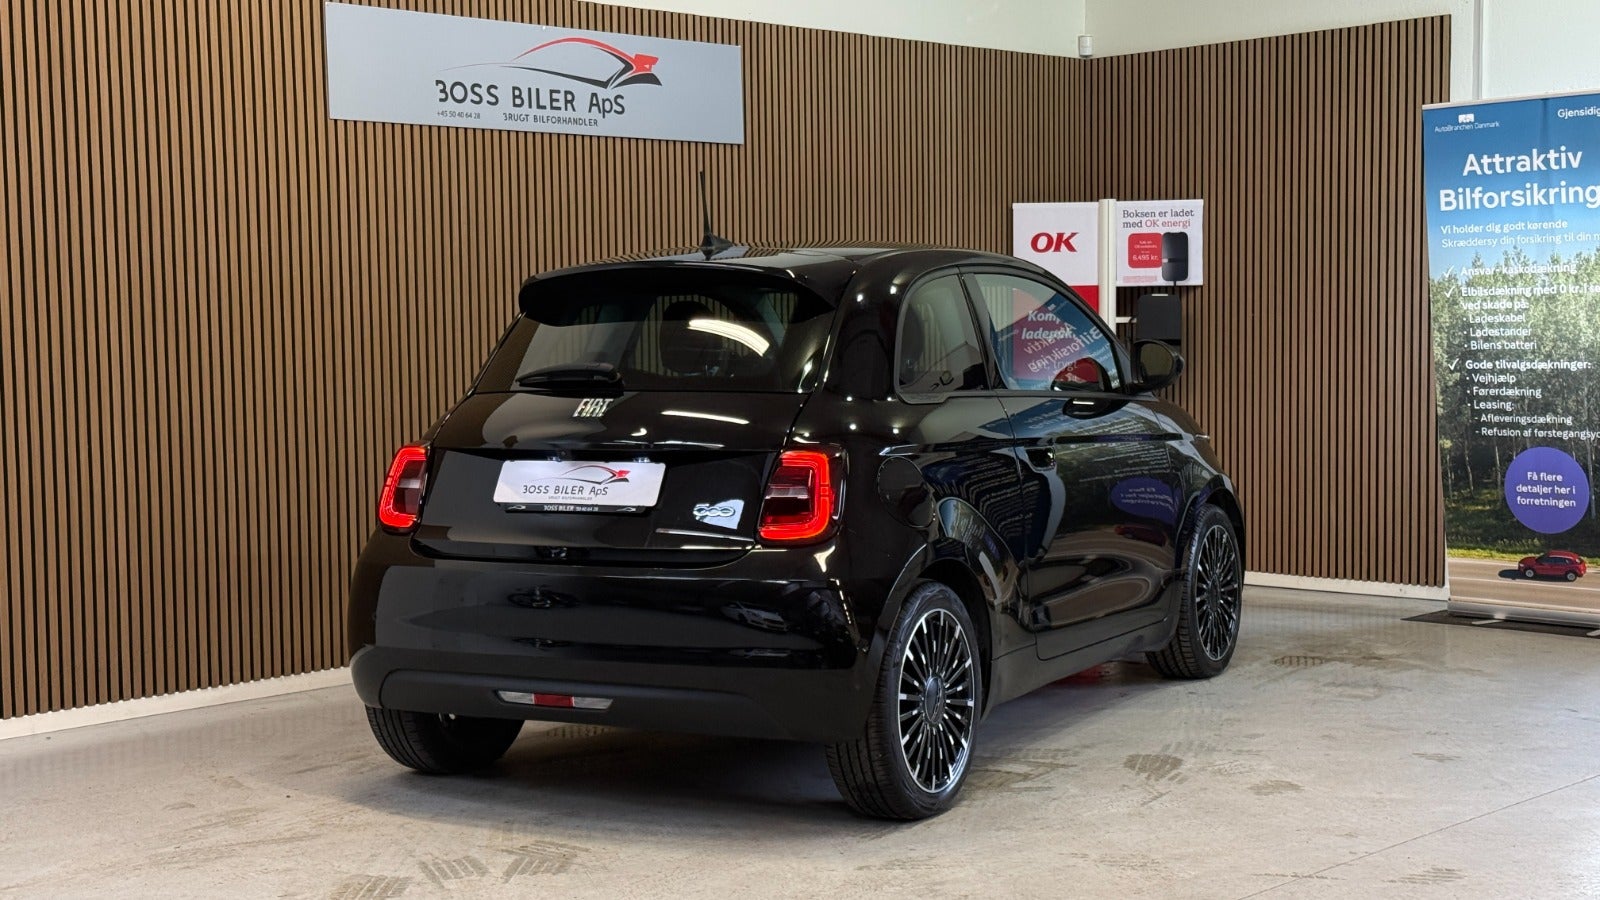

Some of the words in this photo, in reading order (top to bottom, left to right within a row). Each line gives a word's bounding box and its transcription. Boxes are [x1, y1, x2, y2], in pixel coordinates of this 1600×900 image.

[511, 86, 576, 112] BILER
[588, 92, 625, 119] ApS
[533, 115, 598, 127] BILFORHANDLER
[1474, 121, 1500, 129] Danmark
[1463, 145, 1583, 176] Attraktiv
[1439, 181, 1600, 211] Bilforsikring
[1122, 209, 1156, 218] Boksen
[1158, 210, 1168, 218] er
[1170, 208, 1195, 218] ladet
[1122, 220, 1143, 229] med
[1144, 219, 1160, 228] OK
[1161, 218, 1191, 229] energi
[1441, 224, 1452, 234] Vi
[1453, 223, 1483, 233] holder
[1486, 221, 1501, 233] dig
[1503, 220, 1526, 233] godt
[1527, 218, 1568, 230] kørende
[1030, 232, 1080, 253] OK
[1442, 235, 1498, 248] Skræddersy
[1500, 233, 1515, 244] din
[1517, 232, 1562, 246] forsikring
[1564, 231, 1575, 241] til
[1576, 231, 1591, 241] din
[1461, 285, 1532, 298] Elbilsdækning
[1533, 284, 1557, 296] med
[1559, 283, 1567, 294] 0
[1462, 299, 1481, 310] ved
[1482, 299, 1513, 310] skade
[1469, 313, 1527, 324] Ladeskabel
[1469, 327, 1532, 338] Ladestander
[1470, 341, 1502, 350] Bilens
[1503, 340, 1537, 350] batteri
[1465, 360, 1494, 370] Gode
[1472, 373, 1517, 385] Vejhjælp
[1473, 386, 1542, 398] Førerdækning
[572, 398, 614, 418] FIAT
[1480, 413, 1573, 426] Afleveringsdækning
[1481, 427, 1521, 437] Refusion
[1522, 428, 1532, 438] af
[1527, 471, 1538, 481] Få
[1540, 471, 1563, 482] flere
[553, 485, 584, 495] BILER
[588, 486, 608, 497] ApS
[1516, 484, 1552, 495] detaljer
[1554, 485, 1569, 495] her
[1516, 496, 1576, 509] forretningen
